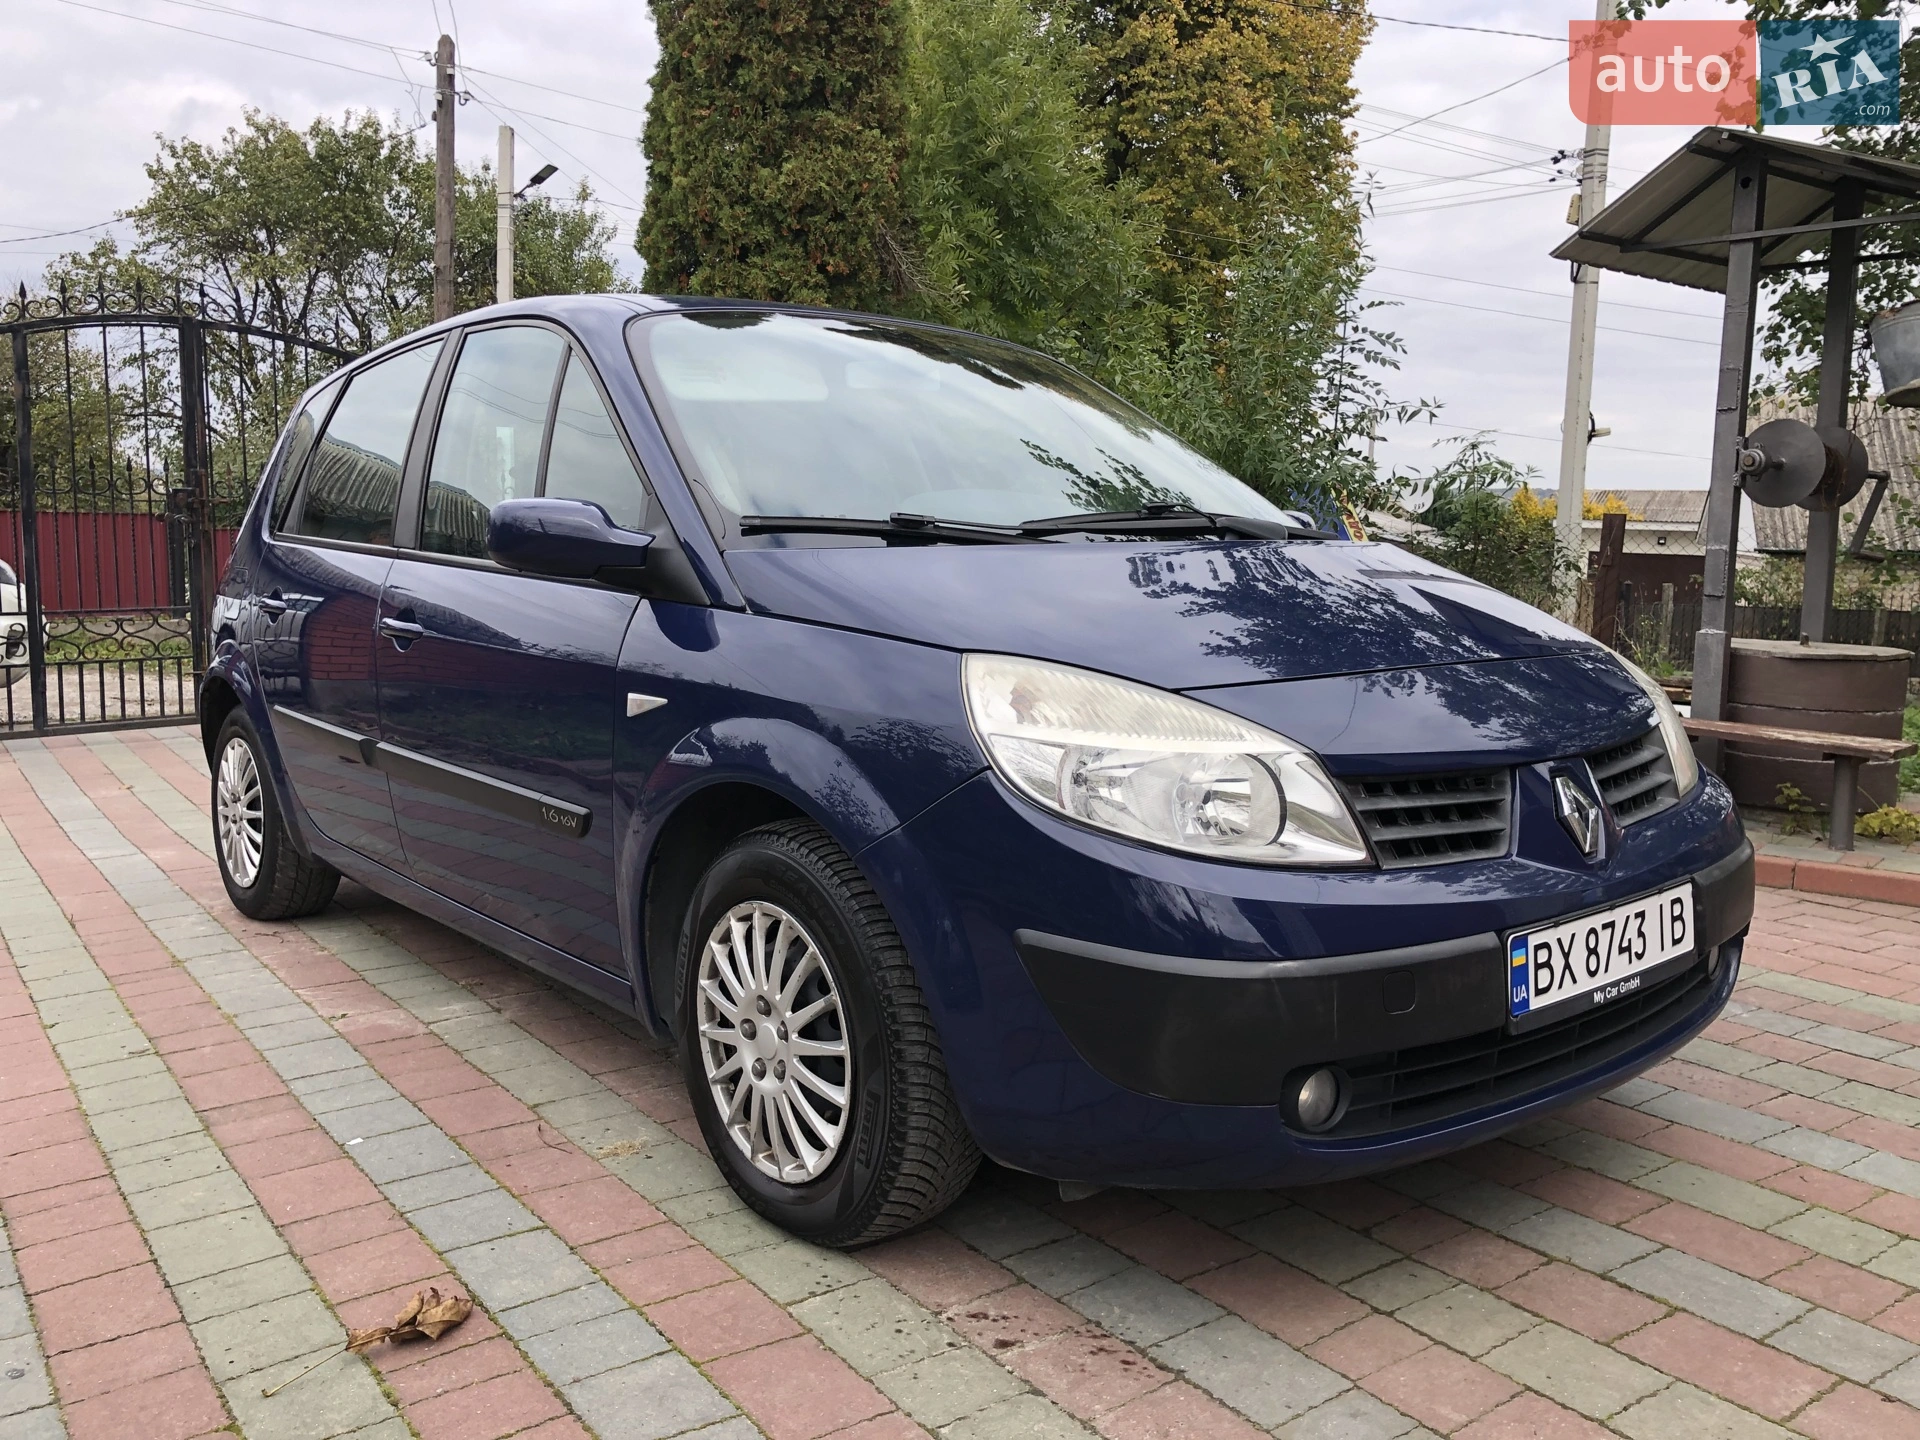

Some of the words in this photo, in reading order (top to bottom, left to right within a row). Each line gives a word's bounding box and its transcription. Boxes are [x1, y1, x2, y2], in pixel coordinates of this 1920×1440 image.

[541, 806, 559, 823] 1.6
[1533, 931, 1578, 997] BX
[1585, 909, 1647, 978] 8743
[1659, 896, 1686, 952] IB
[1513, 986, 1528, 1003] UA
[1593, 990, 1605, 1004] My
[1605, 986, 1618, 999] Car
[1619, 976, 1641, 994] GmbH
